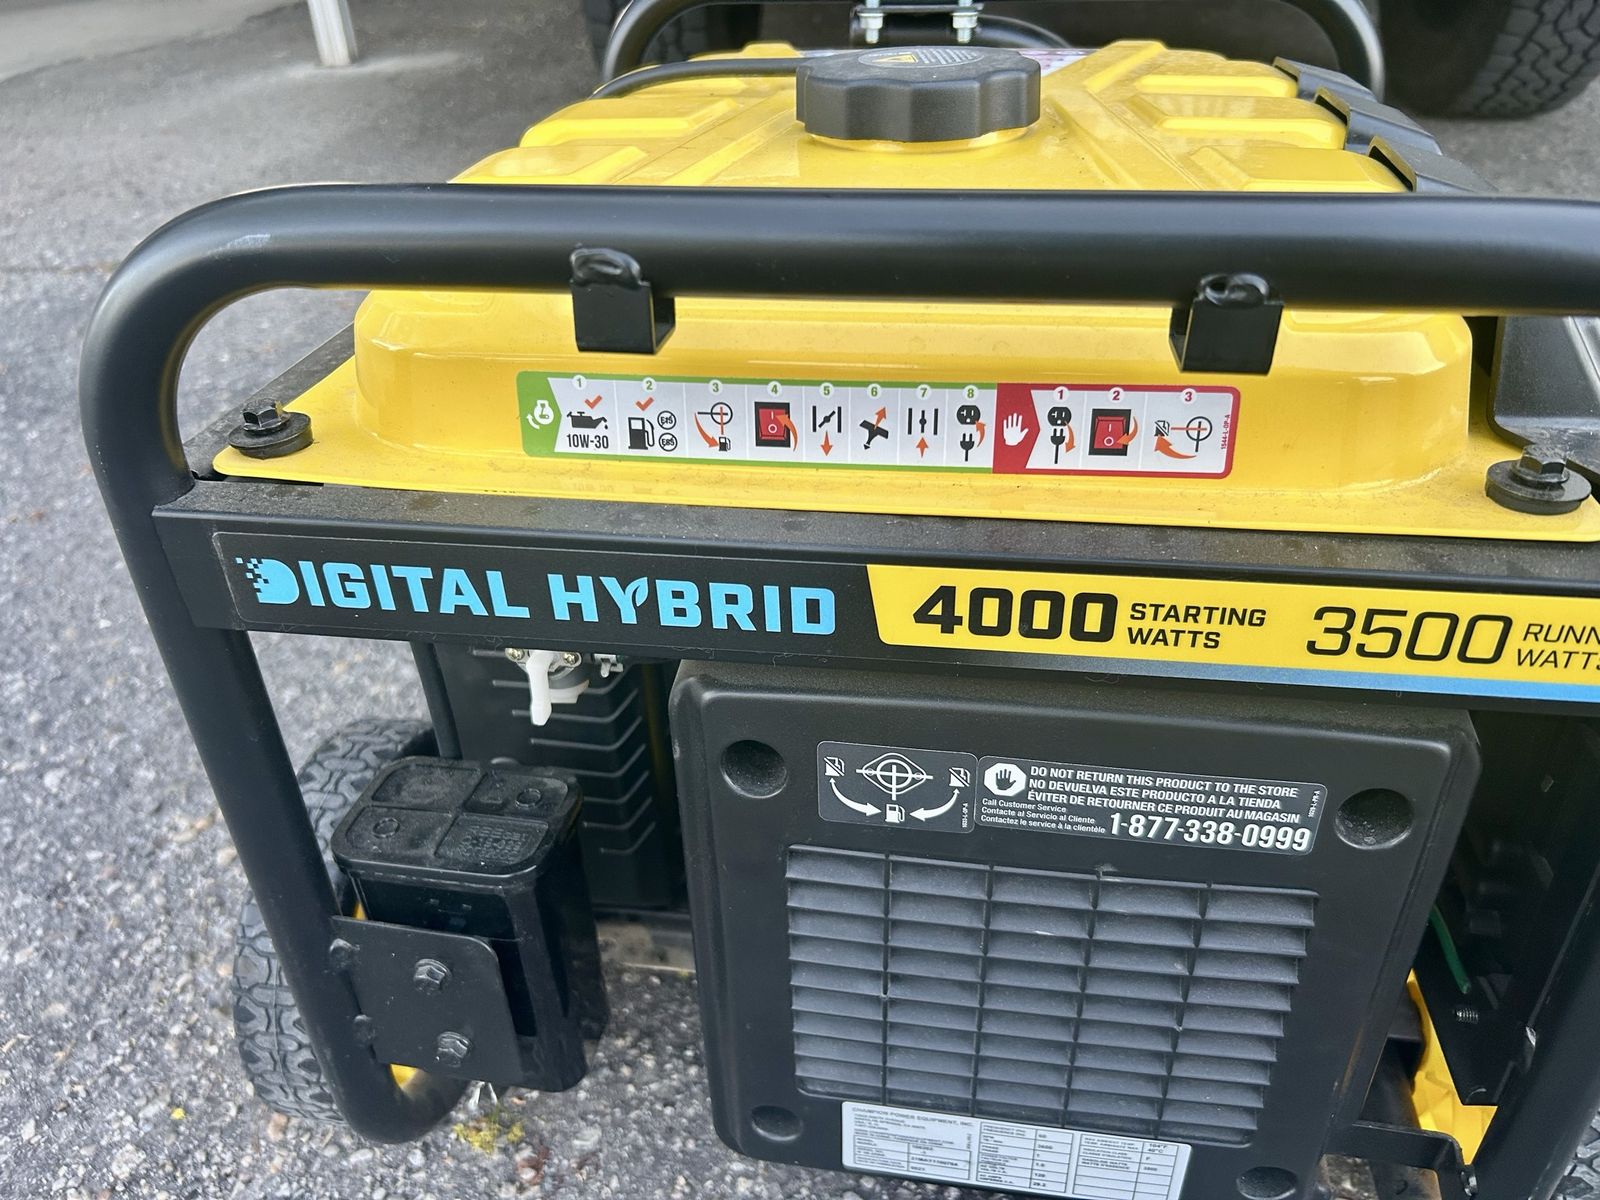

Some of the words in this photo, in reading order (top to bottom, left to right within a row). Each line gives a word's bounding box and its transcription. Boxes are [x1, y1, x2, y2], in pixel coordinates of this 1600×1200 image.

[576, 377, 583, 389] 1
[645, 380, 654, 391] 2
[712, 382, 720, 393] 3
[770, 384, 779, 395] 4
[823, 385, 831, 396] 5
[870, 386, 878, 397] 6
[920, 387, 928, 398] 7
[967, 388, 975, 399] 8
[1058, 389, 1065, 400] 1
[1112, 390, 1120, 401] 2
[1184, 391, 1193, 402] 3
[566, 433, 610, 450] 10W-30
[236, 556, 531, 620] DIGITAL
[547, 572, 837, 636] HYBRID
[912, 585, 1119, 643] 4000
[1129, 602, 1267, 628] STARTING
[1127, 625, 1222, 650] WATTS
[1305, 605, 1514, 665] 3500
[1516, 647, 1600, 671] WATT
[1031, 766, 1047, 777] DO
[1050, 767, 1075, 779] NOT
[1076, 770, 1124, 784] RETURN
[1127, 774, 1154, 787] THIS
[1155, 777, 1213, 792] PRODUCT
[1215, 782, 1230, 792] TO
[1233, 783, 1258, 795] THE
[1258, 785, 1299, 798] STORE
[1029, 778, 1047, 789] NO
[1048, 780, 1107, 796] DEVUELVA
[1110, 785, 1139, 798] ESTE
[1141, 789, 1205, 804] PRODUCTO
[1207, 794, 1217, 804] A
[1220, 795, 1235, 806] LA
[1238, 797, 1282, 810] TIENDA
[982, 798, 997, 807] Call
[998, 799, 1036, 810] Customer
[1037, 803, 1067, 813] Service
[1027, 789, 1068, 804] ÉVITER
[1069, 794, 1086, 806] DE
[1087, 796, 1155, 812] RETOURNER
[1157, 802, 1174, 813] CE
[1174, 804, 1225, 818] PRODUIT
[1225, 808, 1243, 819] AU
[1244, 809, 1301, 824] MAGASIN
[980, 814, 1019, 826] Contactez
[1020, 818, 1027, 826] le
[1028, 820, 1057, 830] service
[1064, 821, 1071, 830] la
[1073, 823, 1106, 834] clientèle
[981, 806, 1016, 817] Contacte
[1017, 809, 1024, 817] al
[1026, 810, 1058, 821] Servicio
[1068, 815, 1096, 825] Cliente
[1110, 811, 1312, 852] 1-877-338-0999
